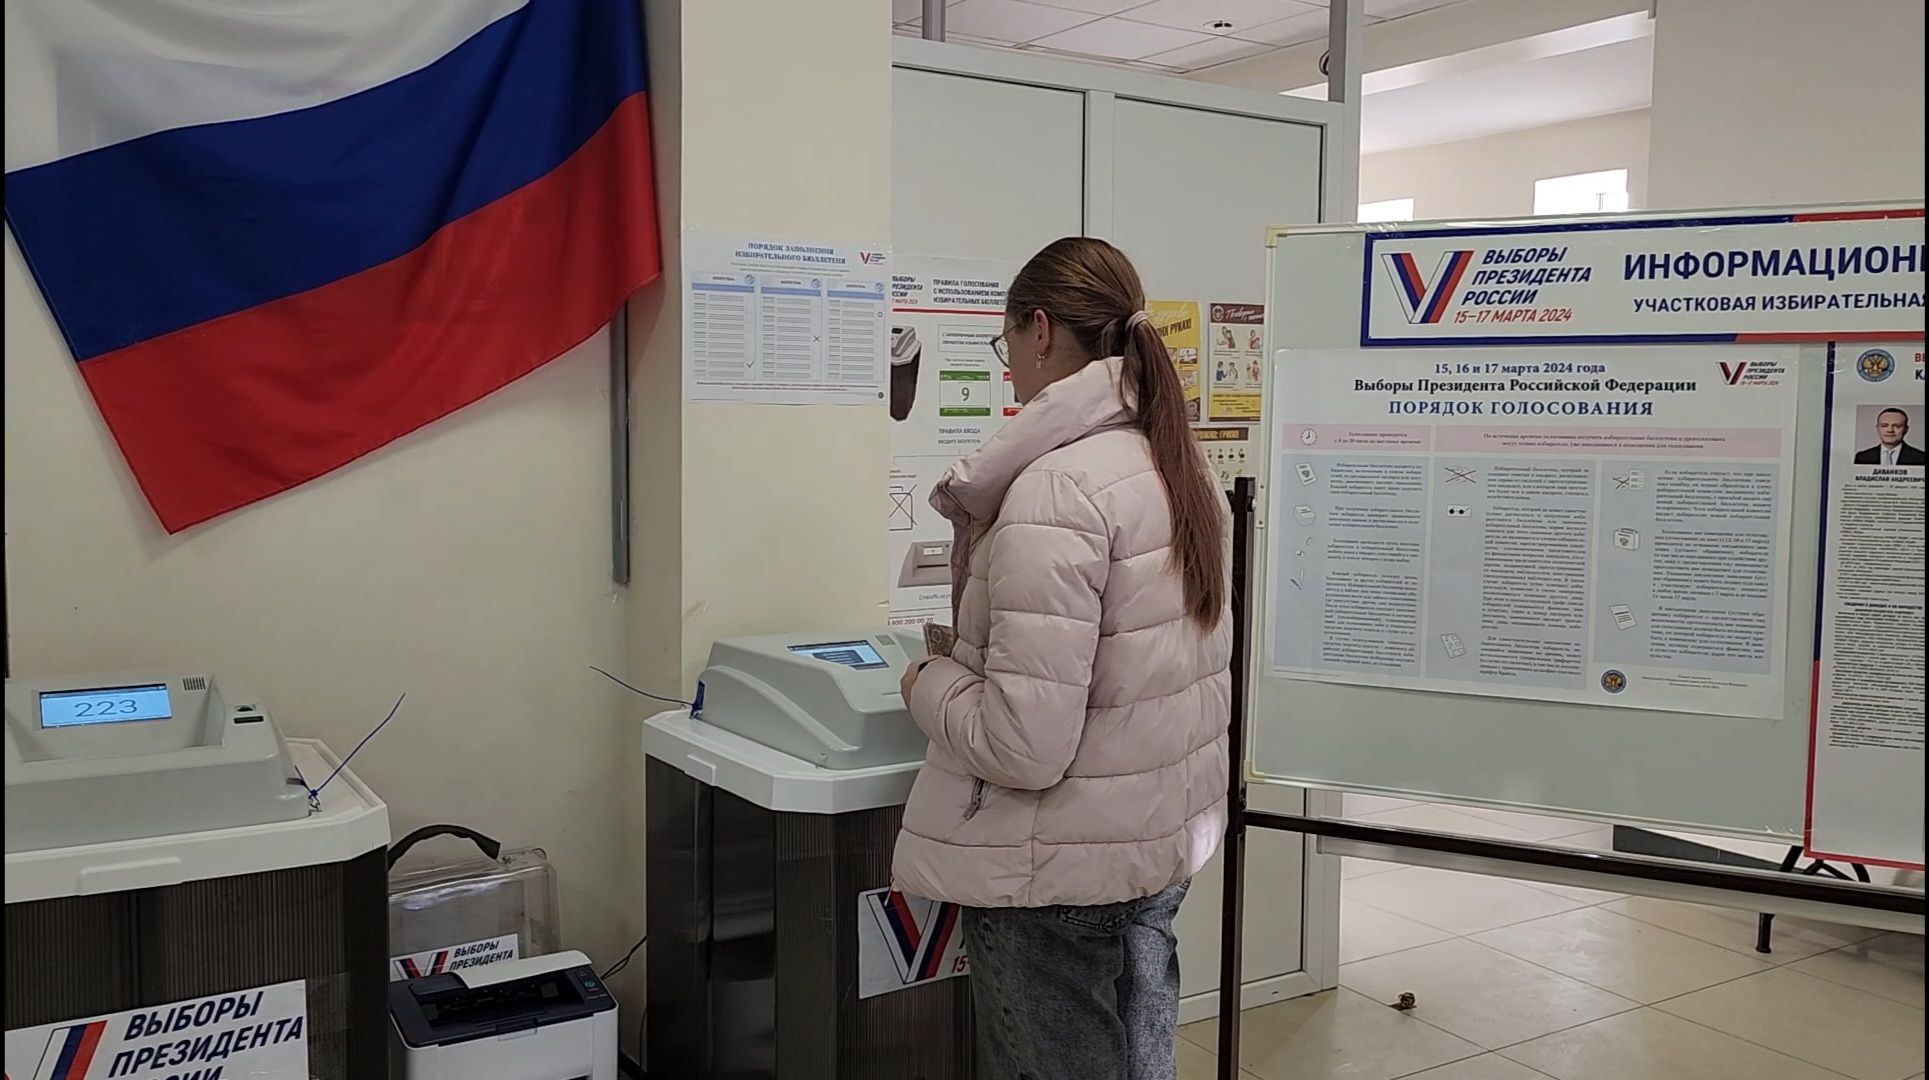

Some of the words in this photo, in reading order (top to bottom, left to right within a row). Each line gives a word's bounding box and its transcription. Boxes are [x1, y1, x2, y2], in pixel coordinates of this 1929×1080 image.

[748, 242, 784, 252] ПОРЯДОК
[1482, 247, 1568, 265] ВЫБОРЫ
[1623, 245, 1925, 281] ИНФОРМАЦИОН
[960, 280, 999, 288] ГОЛОСОВАНИЯ
[1471, 267, 1592, 286] ПРЕЗИДЕНТА
[1461, 289, 1538, 306] РОССИИ
[1633, 296, 1756, 313] УЧАСТКОВАЯ
[1491, 309, 1539, 323] МАРТА
[1539, 308, 1573, 322] 2024
[1434, 364, 1452, 376] 15,
[1456, 363, 1470, 373] 16
[1484, 363, 1499, 373] 17
[1501, 365, 1540, 376] марта
[1543, 363, 1573, 373] 2024
[1576, 365, 1606, 376] года
[961, 387, 970, 401] 9
[1354, 378, 1414, 394] Выборы
[1417, 378, 1506, 394] Президента
[1510, 378, 1601, 392] Российской
[1604, 378, 1697, 394] Федерации
[1388, 401, 1484, 416] ПОРЯДОК
[1490, 401, 1654, 416] ГОЛОСОВАНИЯ
[73, 699, 138, 718] 223
[453, 940, 500, 958] ВЫБОРЫ
[449, 949, 514, 971] ПРЕЗИДЕНТА
[124, 991, 264, 1042] ВЫБОРЫ
[108, 1016, 304, 1079] ПРЕЗИДЕНТА
